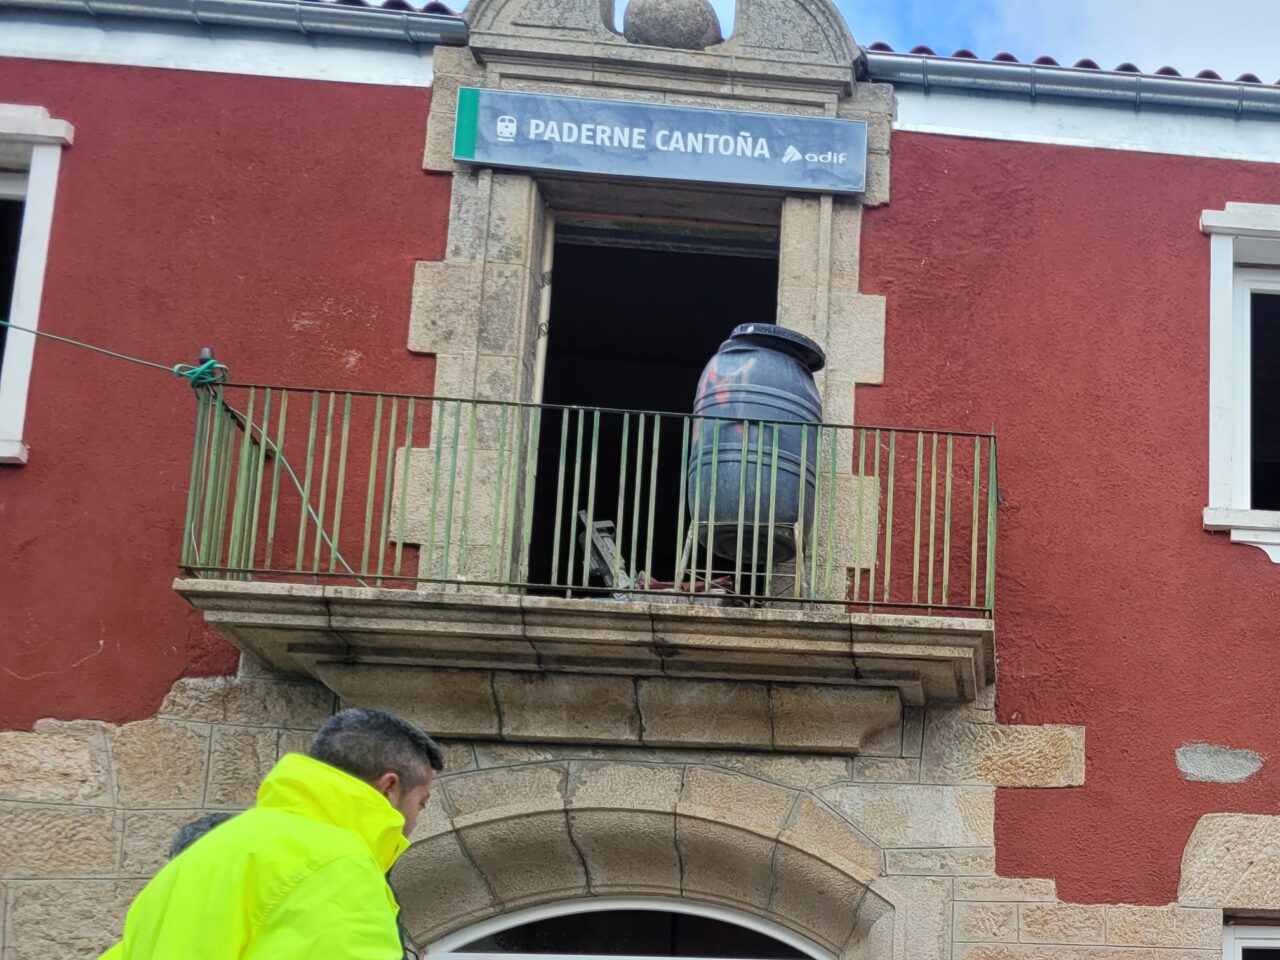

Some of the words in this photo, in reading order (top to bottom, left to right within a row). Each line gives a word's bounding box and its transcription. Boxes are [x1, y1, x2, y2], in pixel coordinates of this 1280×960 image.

[528, 118, 647, 149] PADERNE
[654, 129, 771, 159] CANTOÑA
[804, 151, 849, 165] adif
